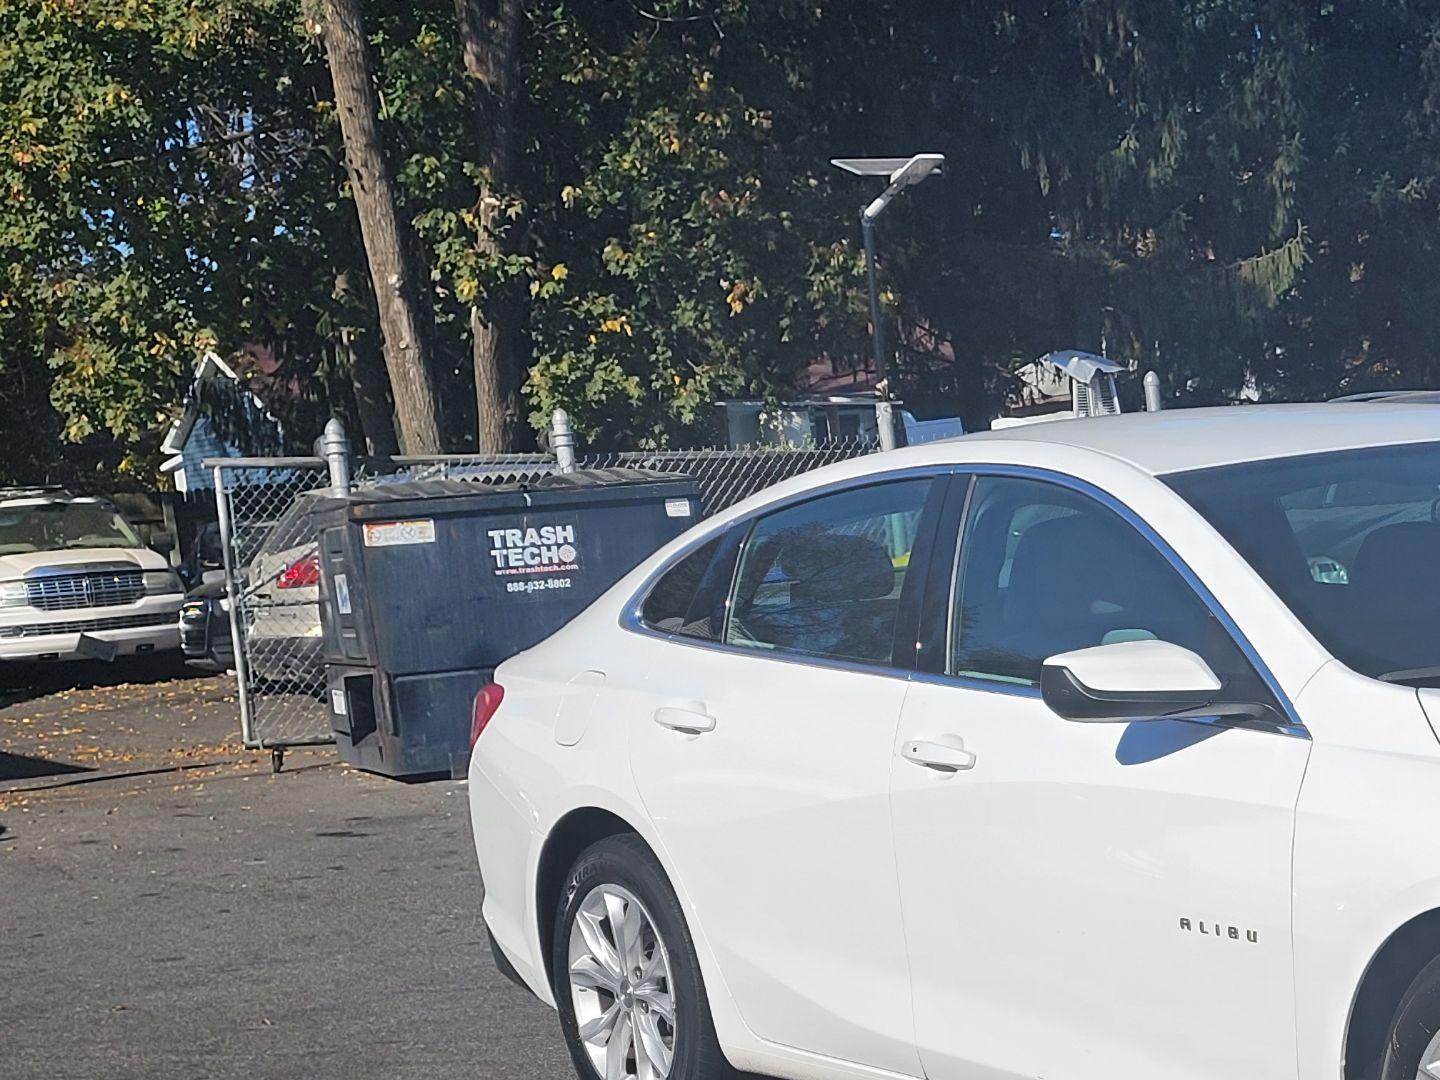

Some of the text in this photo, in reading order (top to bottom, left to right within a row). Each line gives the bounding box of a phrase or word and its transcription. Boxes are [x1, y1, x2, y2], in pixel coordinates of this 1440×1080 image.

[487, 524, 575, 549] TRASH
[494, 564, 579, 576] www.trashtech.com
[1179, 917, 1258, 943] ALIBU
